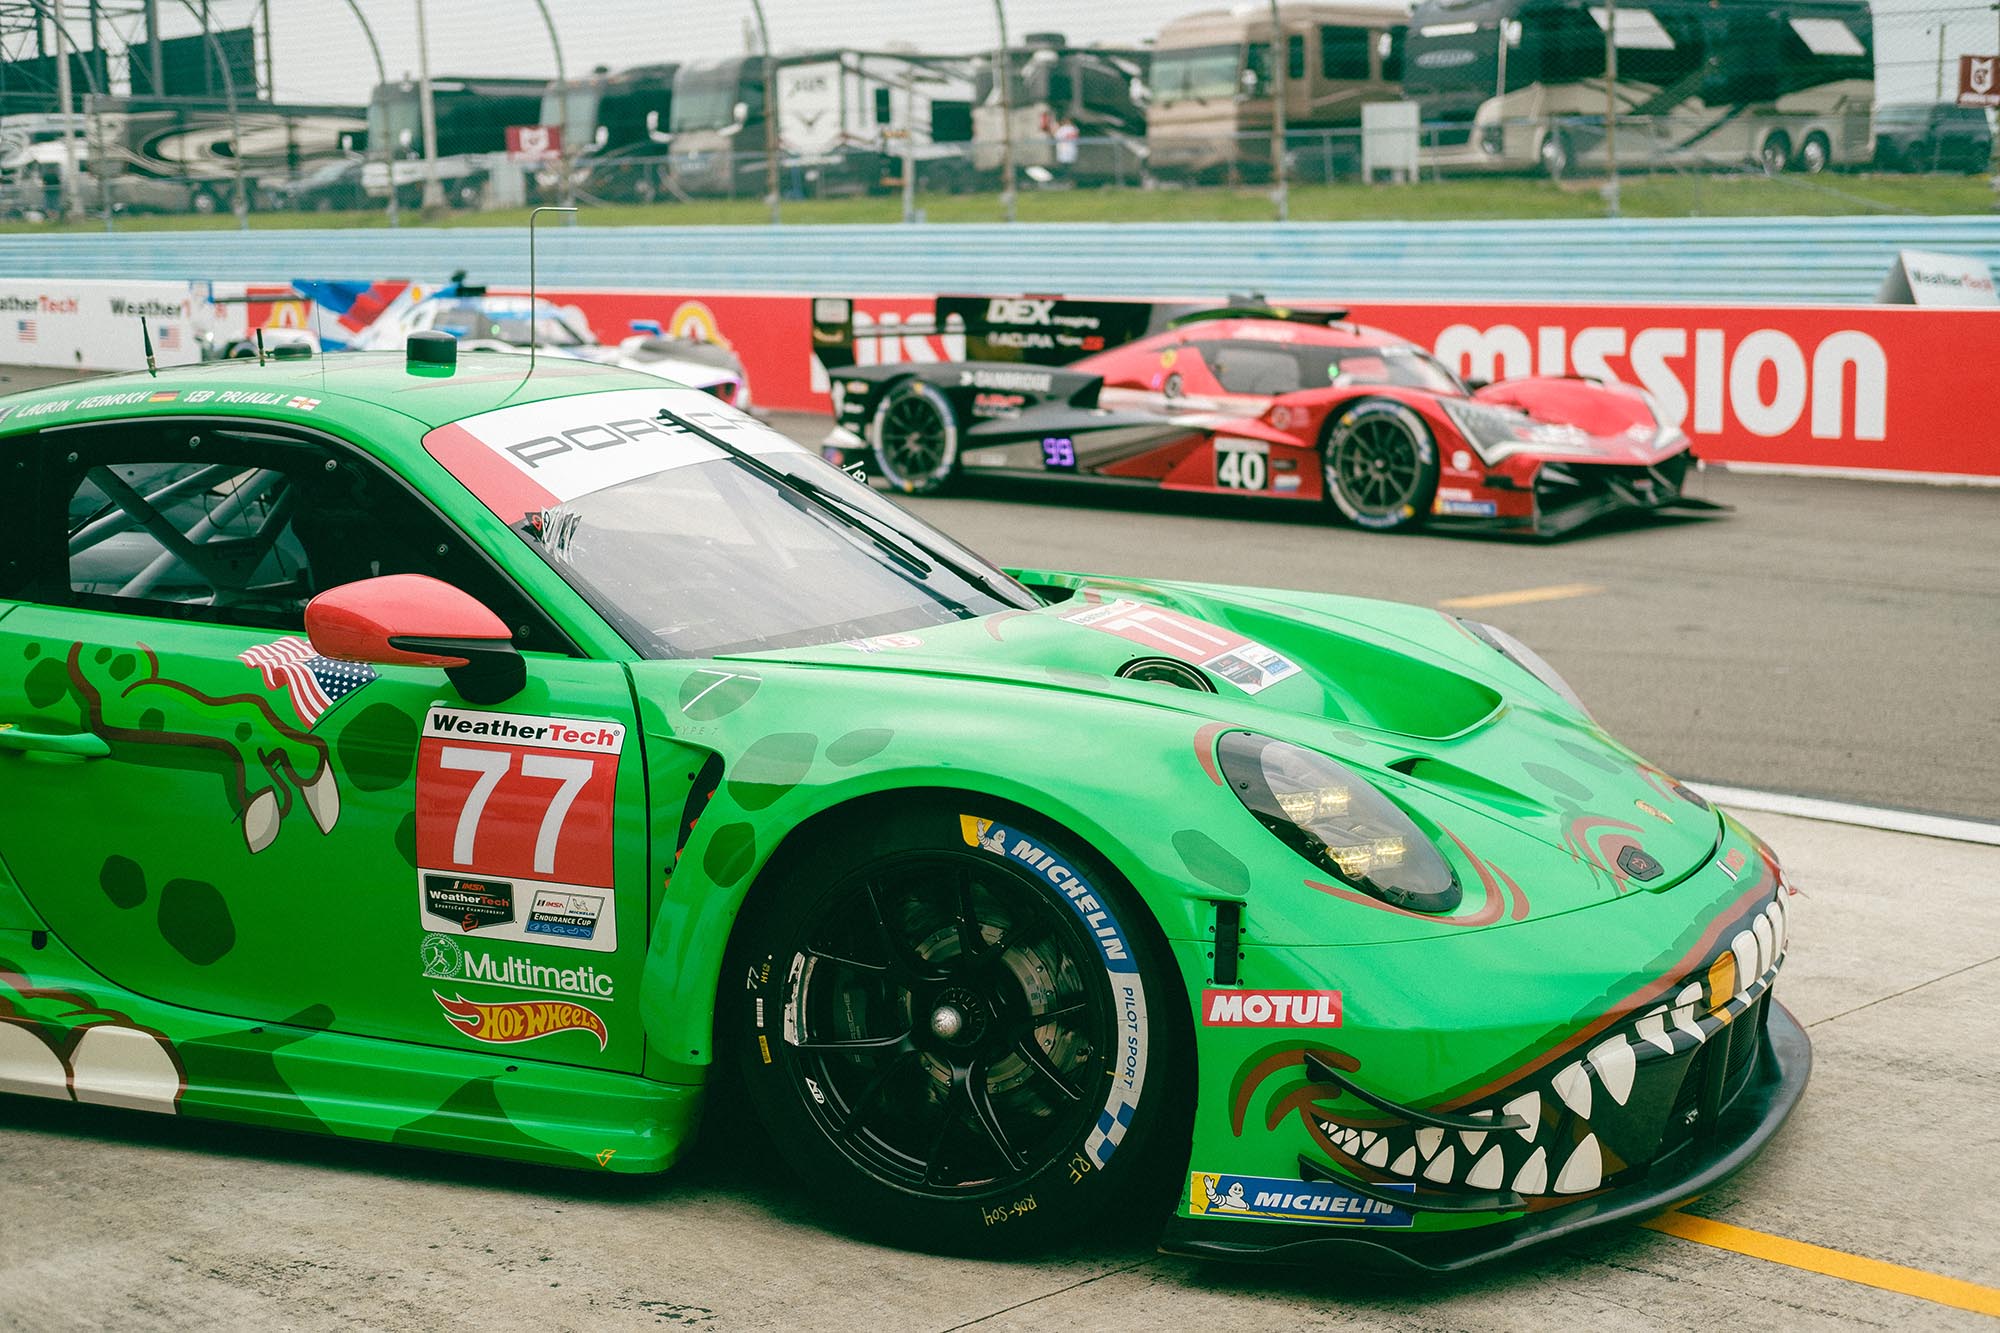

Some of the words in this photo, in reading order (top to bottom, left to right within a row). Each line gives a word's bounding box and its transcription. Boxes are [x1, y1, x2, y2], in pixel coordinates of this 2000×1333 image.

[986, 299, 1056, 325] DEX
[15, 400, 75, 418] LAURIN
[76, 391, 152, 410] HEINRICH
[183, 390, 216, 403] SEB
[216, 391, 289, 405] PRIAULX
[1043, 437, 1075, 466] 99
[1218, 450, 1267, 490] 40
[440, 746, 594, 874] 77
[429, 890, 510, 907] WeatherTech
[461, 882, 486, 892] IMSA
[1010, 839, 1127, 961] MICHELIN
[568, 910, 595, 918] MICHELIN
[464, 951, 614, 996] Multimatic
[1121, 986, 1138, 1033] PILOT
[1209, 995, 1336, 1024] MOTUL
[1123, 1036, 1139, 1088] SPORT
[1069, 1151, 1092, 1184] RF
[1254, 1191, 1394, 1215] MICHELIN
